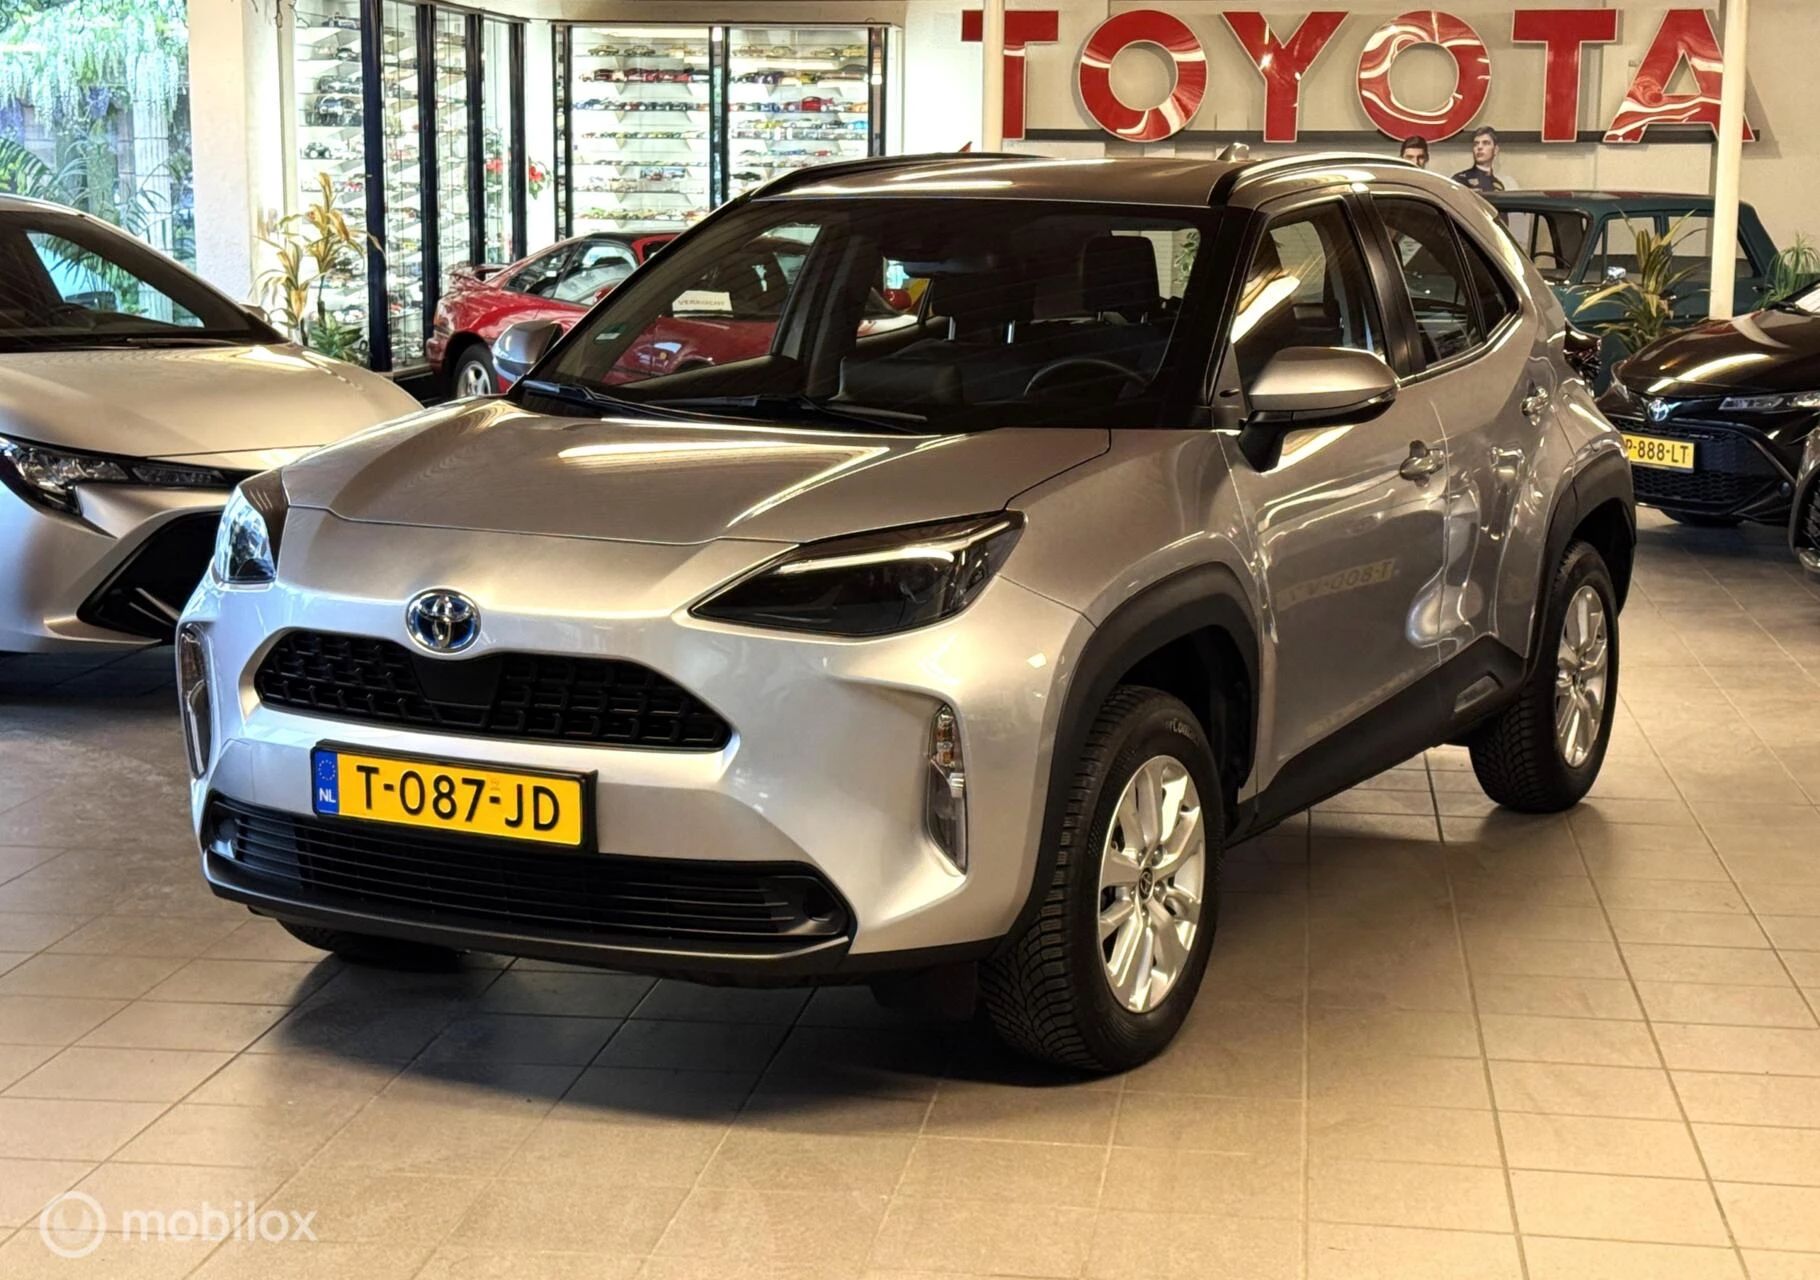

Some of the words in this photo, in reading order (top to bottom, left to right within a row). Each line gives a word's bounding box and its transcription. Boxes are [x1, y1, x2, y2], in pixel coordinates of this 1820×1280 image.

[961, 9, 1756, 143] TOYOTA
[318, 787, 337, 804] NL
[357, 765, 560, 831] T-087-JD
